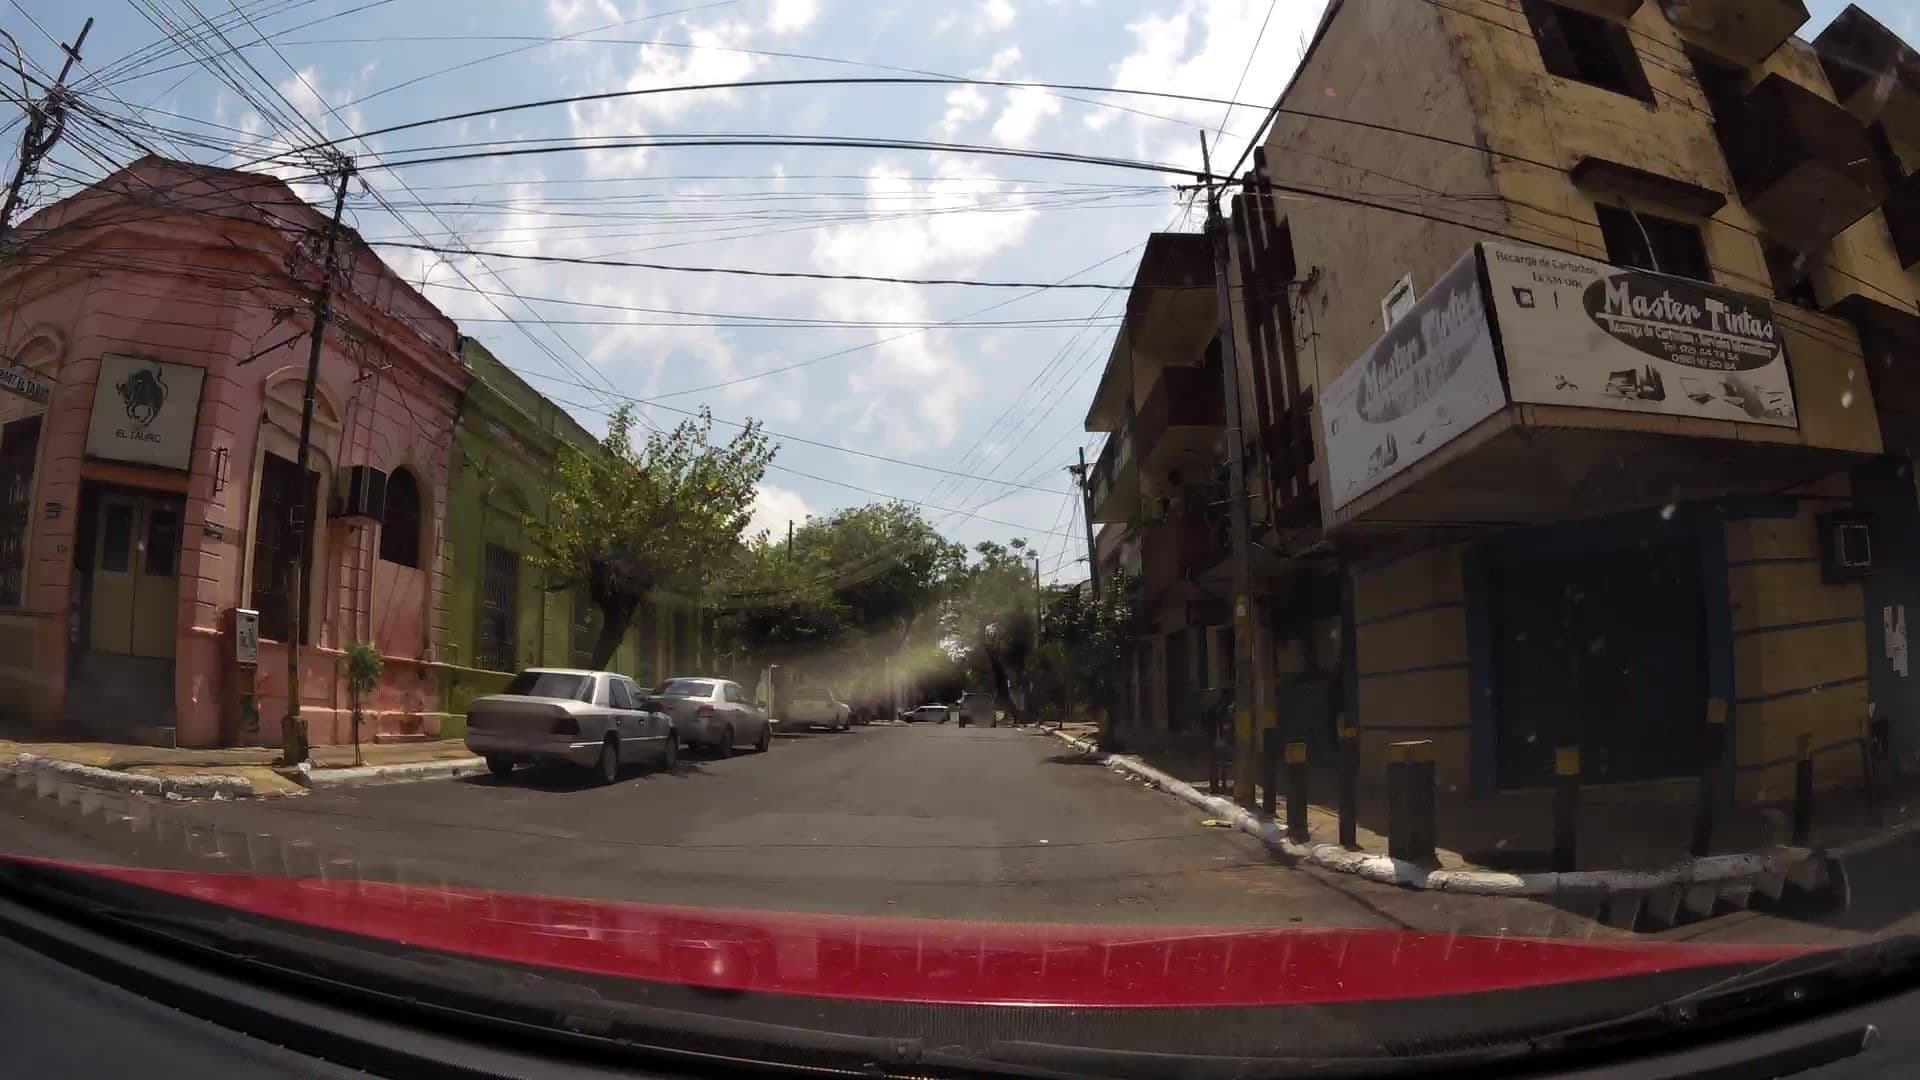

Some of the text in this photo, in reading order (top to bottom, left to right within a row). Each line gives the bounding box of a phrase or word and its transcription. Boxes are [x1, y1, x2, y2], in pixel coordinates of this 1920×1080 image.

[1496, 251, 1537, 267] Recarga
[1604, 275, 1774, 340] Master Tintas
[115, 429, 161, 443] EL TAURO
